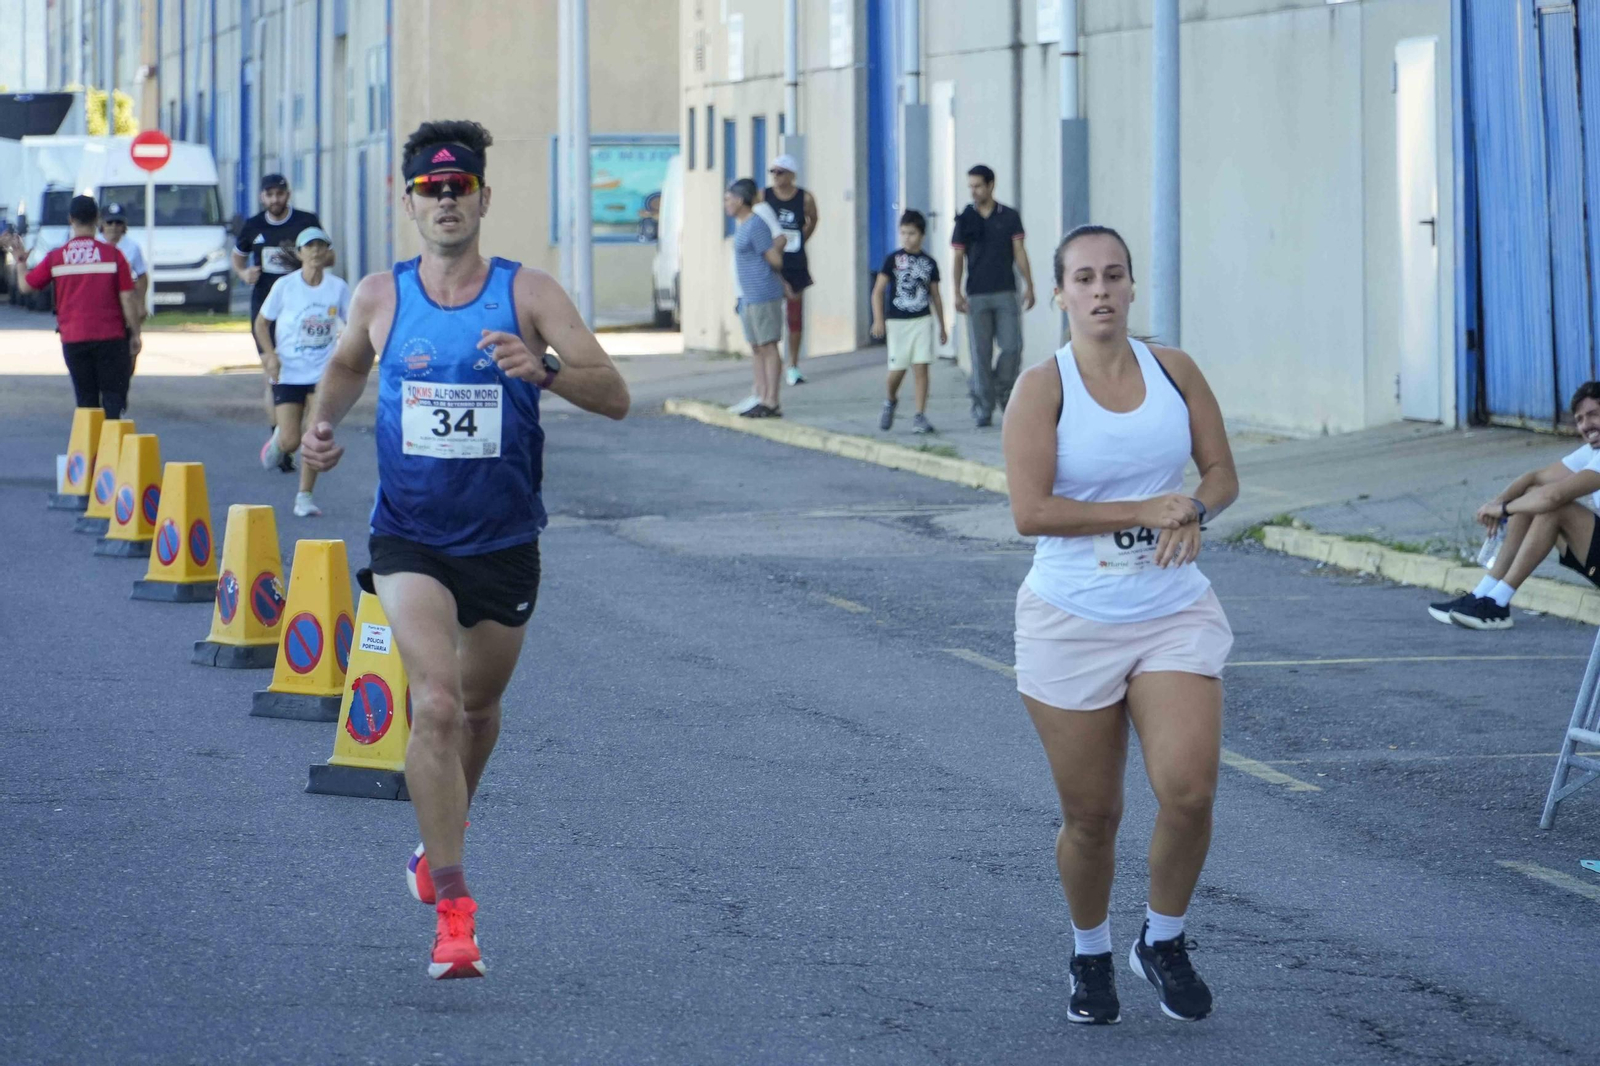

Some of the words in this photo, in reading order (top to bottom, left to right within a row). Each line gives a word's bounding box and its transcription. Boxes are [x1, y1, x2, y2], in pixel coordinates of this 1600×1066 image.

[435, 388, 472, 399] ALFONSO
[474, 389, 499, 400] MORO
[431, 408, 478, 437] 34
[1113, 527, 1160, 549] 64
[362, 643, 387, 651] PORTUARIA
